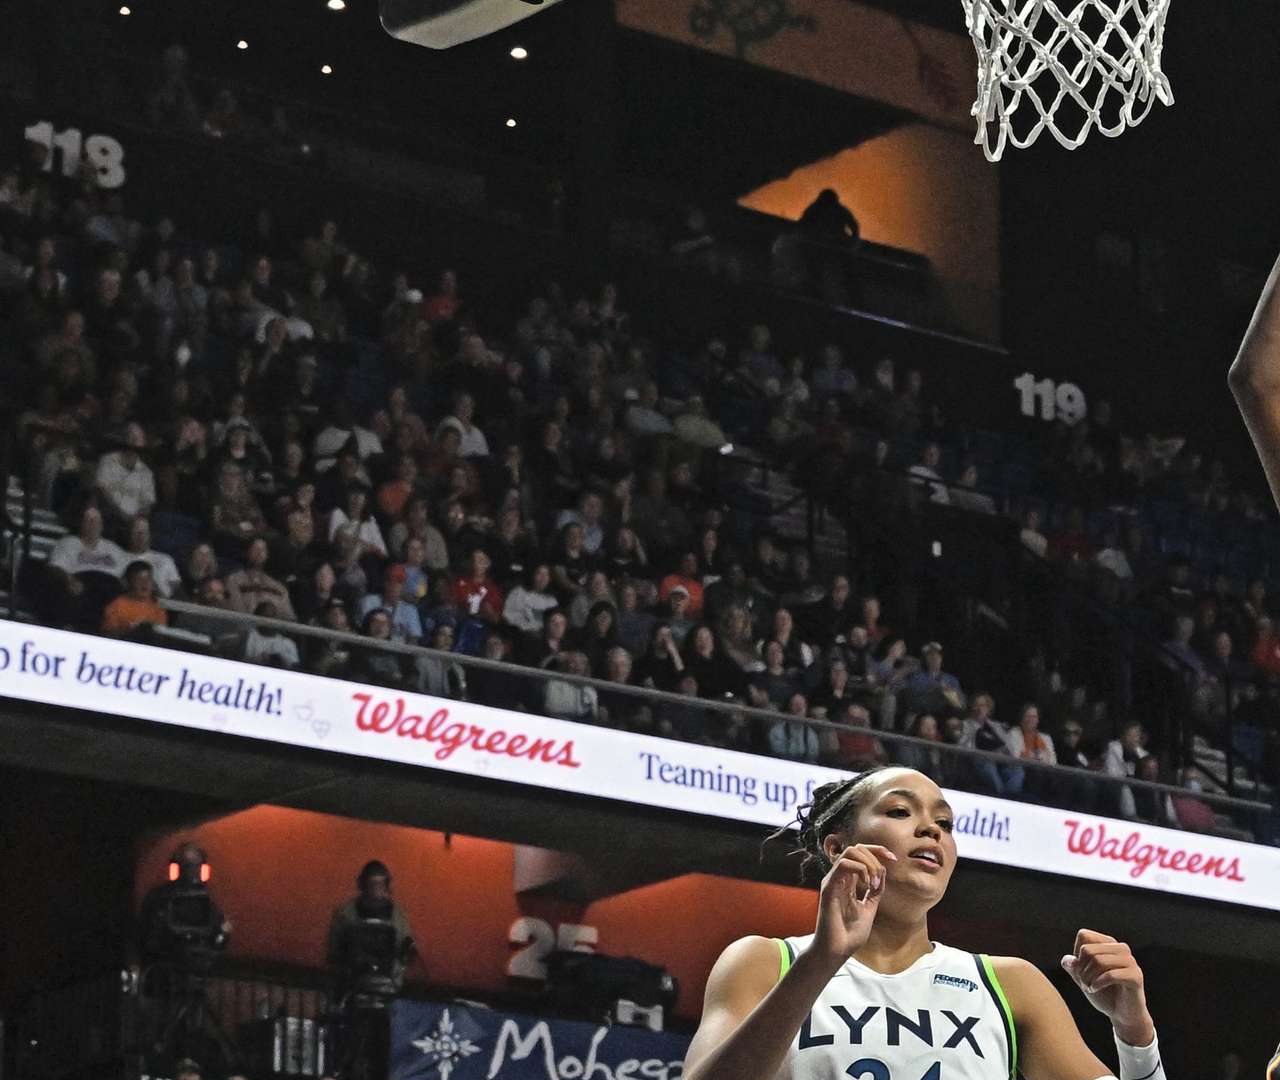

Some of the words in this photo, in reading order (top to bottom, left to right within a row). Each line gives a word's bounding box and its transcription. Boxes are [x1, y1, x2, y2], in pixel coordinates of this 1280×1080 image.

[1014, 373, 1087, 425] 119
[20, 640, 66, 677] for
[76, 652, 170, 696] better
[177, 669, 283, 715] health!
[353, 693, 581, 768] Walgreens
[640, 752, 758, 805] Teaming
[764, 781, 798, 812] up
[953, 808, 1010, 842] alth!
[1064, 819, 1246, 882] Walgreens
[799, 1004, 985, 1059] LYNX
